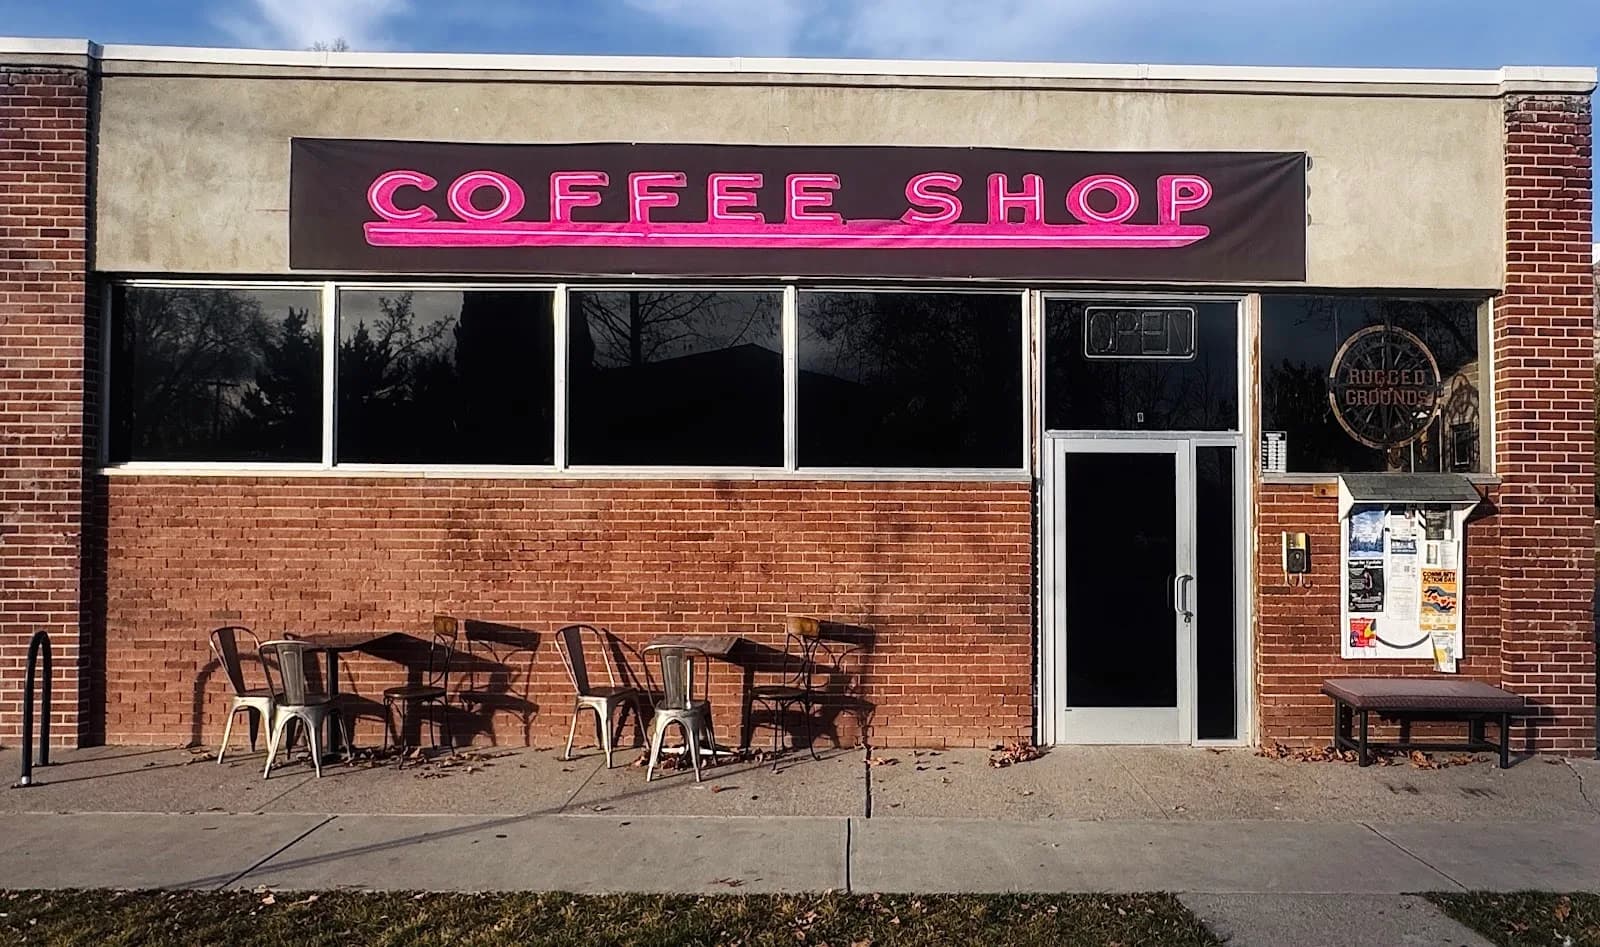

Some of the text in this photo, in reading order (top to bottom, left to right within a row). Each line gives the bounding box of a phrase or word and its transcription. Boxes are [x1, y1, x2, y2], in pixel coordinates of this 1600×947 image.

[367, 169, 1213, 227] COFFEE SHOP
[1090, 311, 1190, 354] OPEN
[1349, 368, 1425, 385] RUGGED
[1344, 388, 1434, 406] GROUNDS
